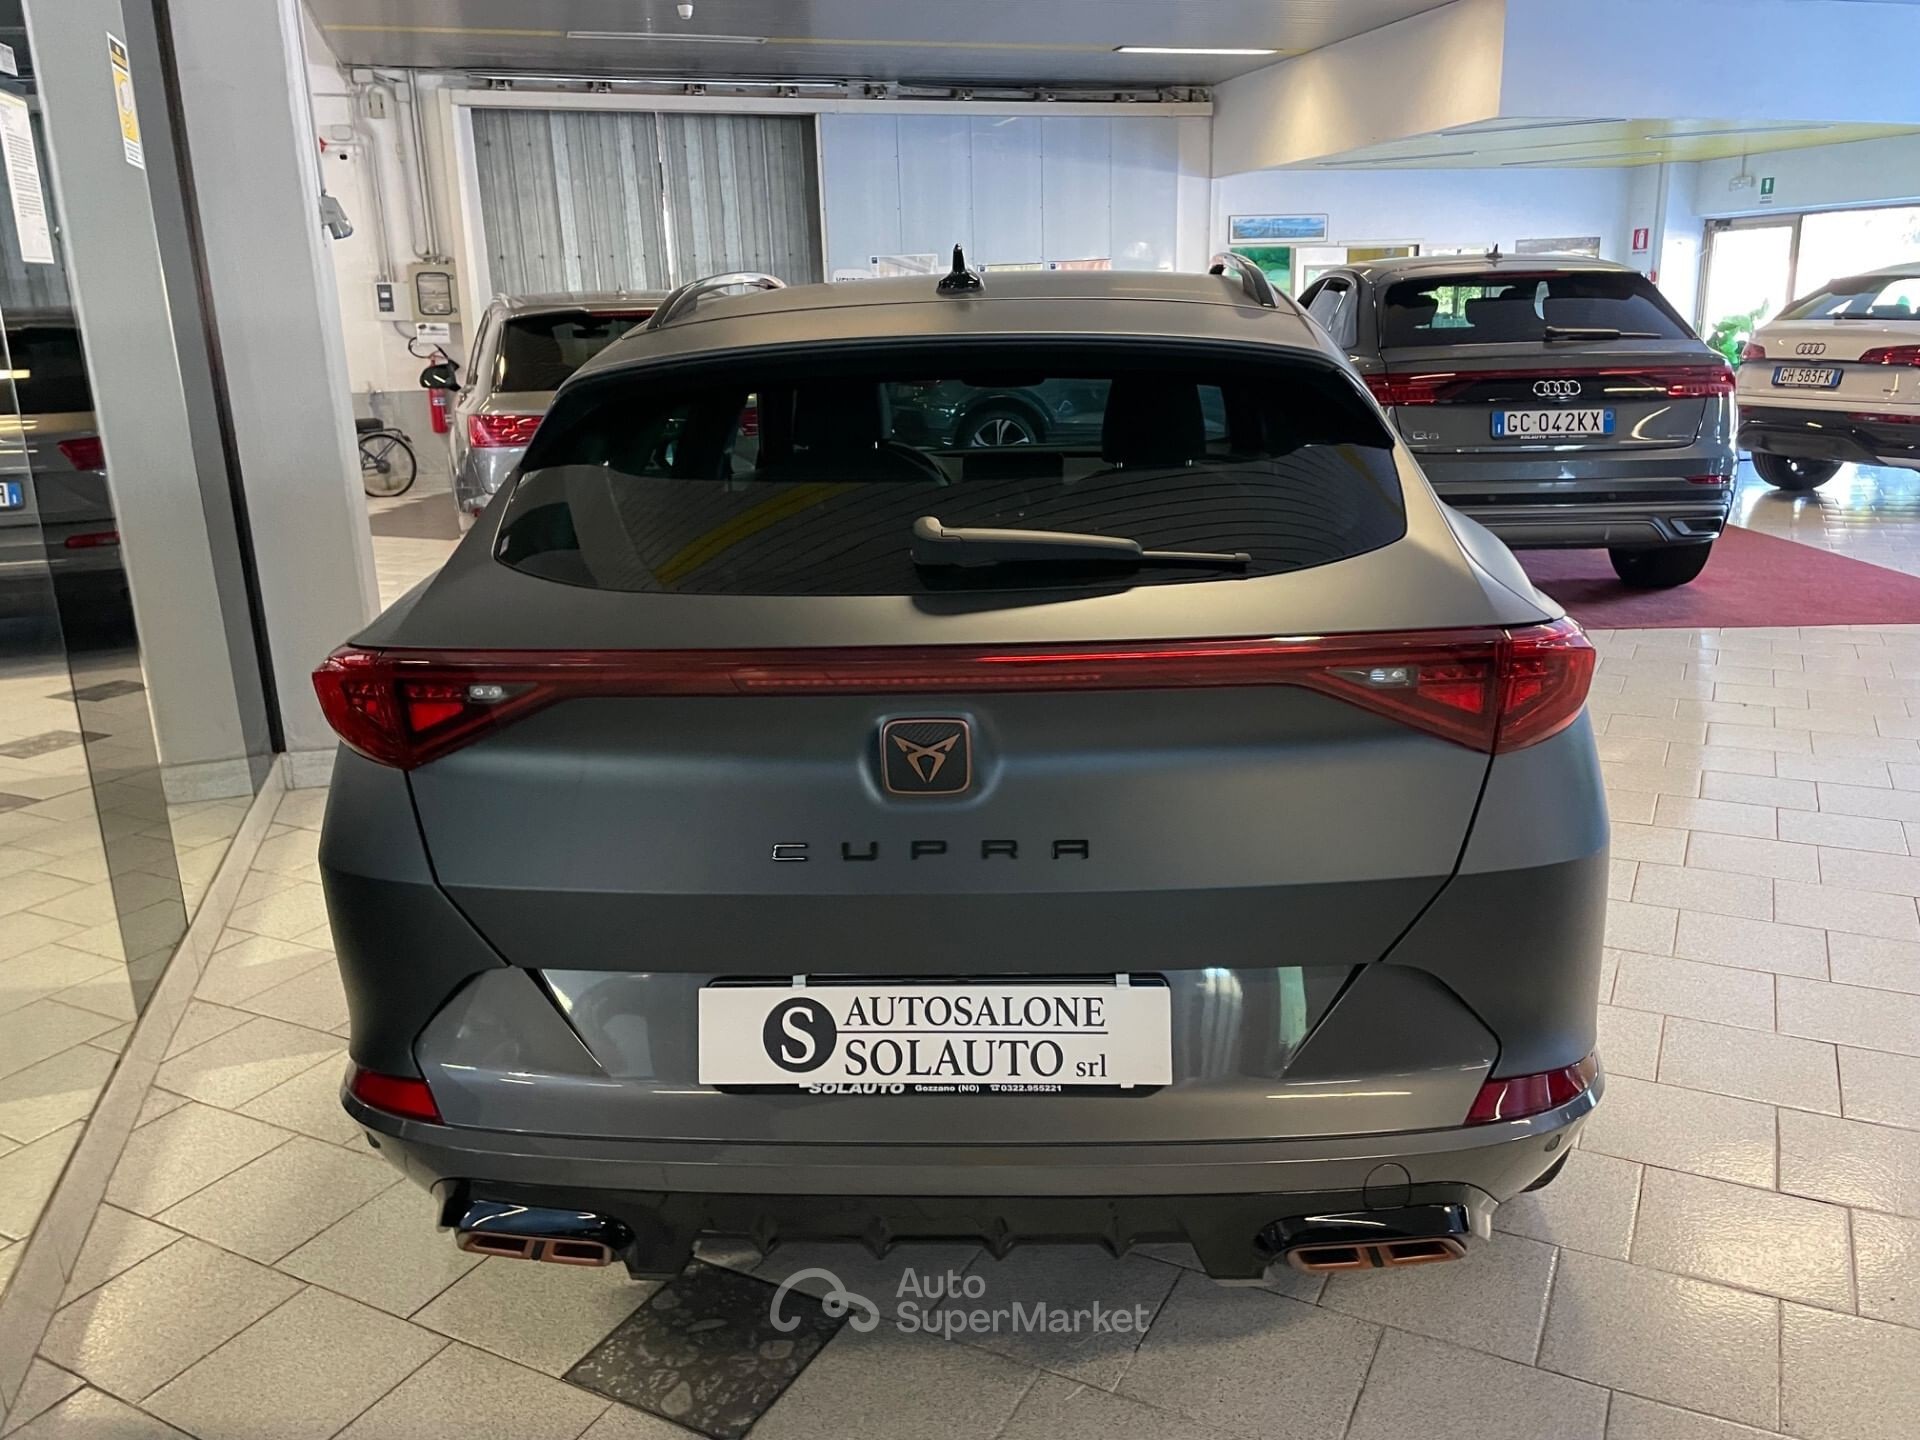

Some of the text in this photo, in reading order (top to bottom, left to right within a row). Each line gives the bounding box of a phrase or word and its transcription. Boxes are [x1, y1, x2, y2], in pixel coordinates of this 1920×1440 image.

[1780, 368, 1832, 384] GH 583FK
[1506, 412, 1531, 433] GC
[1538, 410, 1601, 432] 042KX
[772, 839, 1090, 862] CUPRA
[843, 995, 1106, 1027] AUTOSALONE
[780, 1006, 816, 1064] S
[844, 1038, 1107, 1078] SOLAUTO srl
[808, 1083, 905, 1094] SOLAUTO
[914, 1083, 956, 1092] Gozzano
[958, 1084, 980, 1093] (NO)
